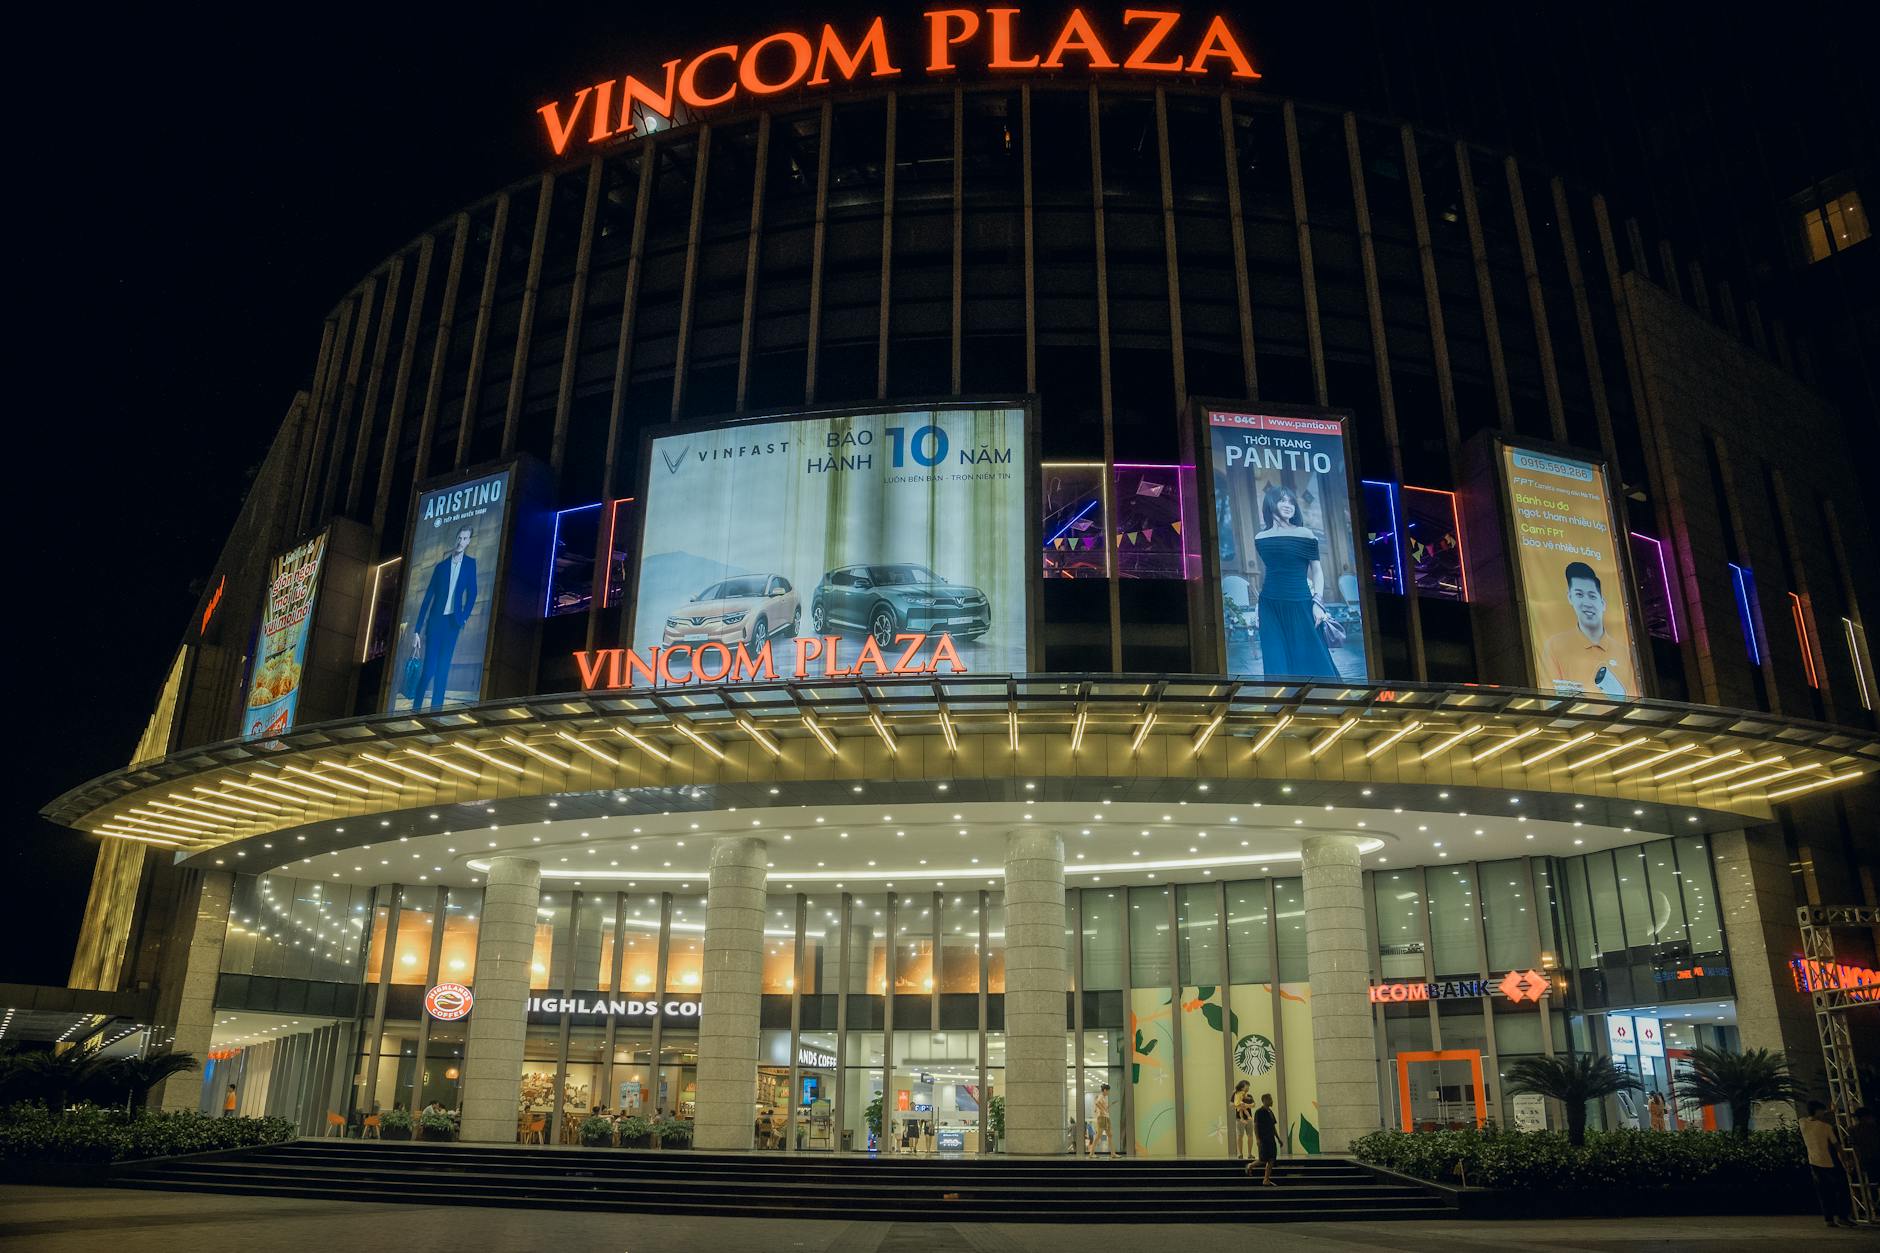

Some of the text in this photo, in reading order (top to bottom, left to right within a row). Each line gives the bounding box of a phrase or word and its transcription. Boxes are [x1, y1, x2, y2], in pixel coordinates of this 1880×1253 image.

[537, 8, 1262, 155] VINCOM PLAZA
[1268, 418, 1338, 430] www.pantio.vn
[826, 429, 873, 448] BẢO
[886, 425, 1012, 468] 10 NĂM
[1243, 434, 1311, 450] THỜI TRANG
[697, 441, 789, 462] VINFAST
[1225, 445, 1331, 474] PANTIO
[808, 453, 873, 474] HÀNH
[424, 480, 502, 520] ARISTINO
[1515, 493, 1542, 505] Bánh
[1546, 527, 1564, 538] FPT
[573, 633, 967, 690] VINCOM PLAZA
[428, 984, 471, 1002] HIGHLANDS
[432, 1009, 465, 1018] COFFEE
